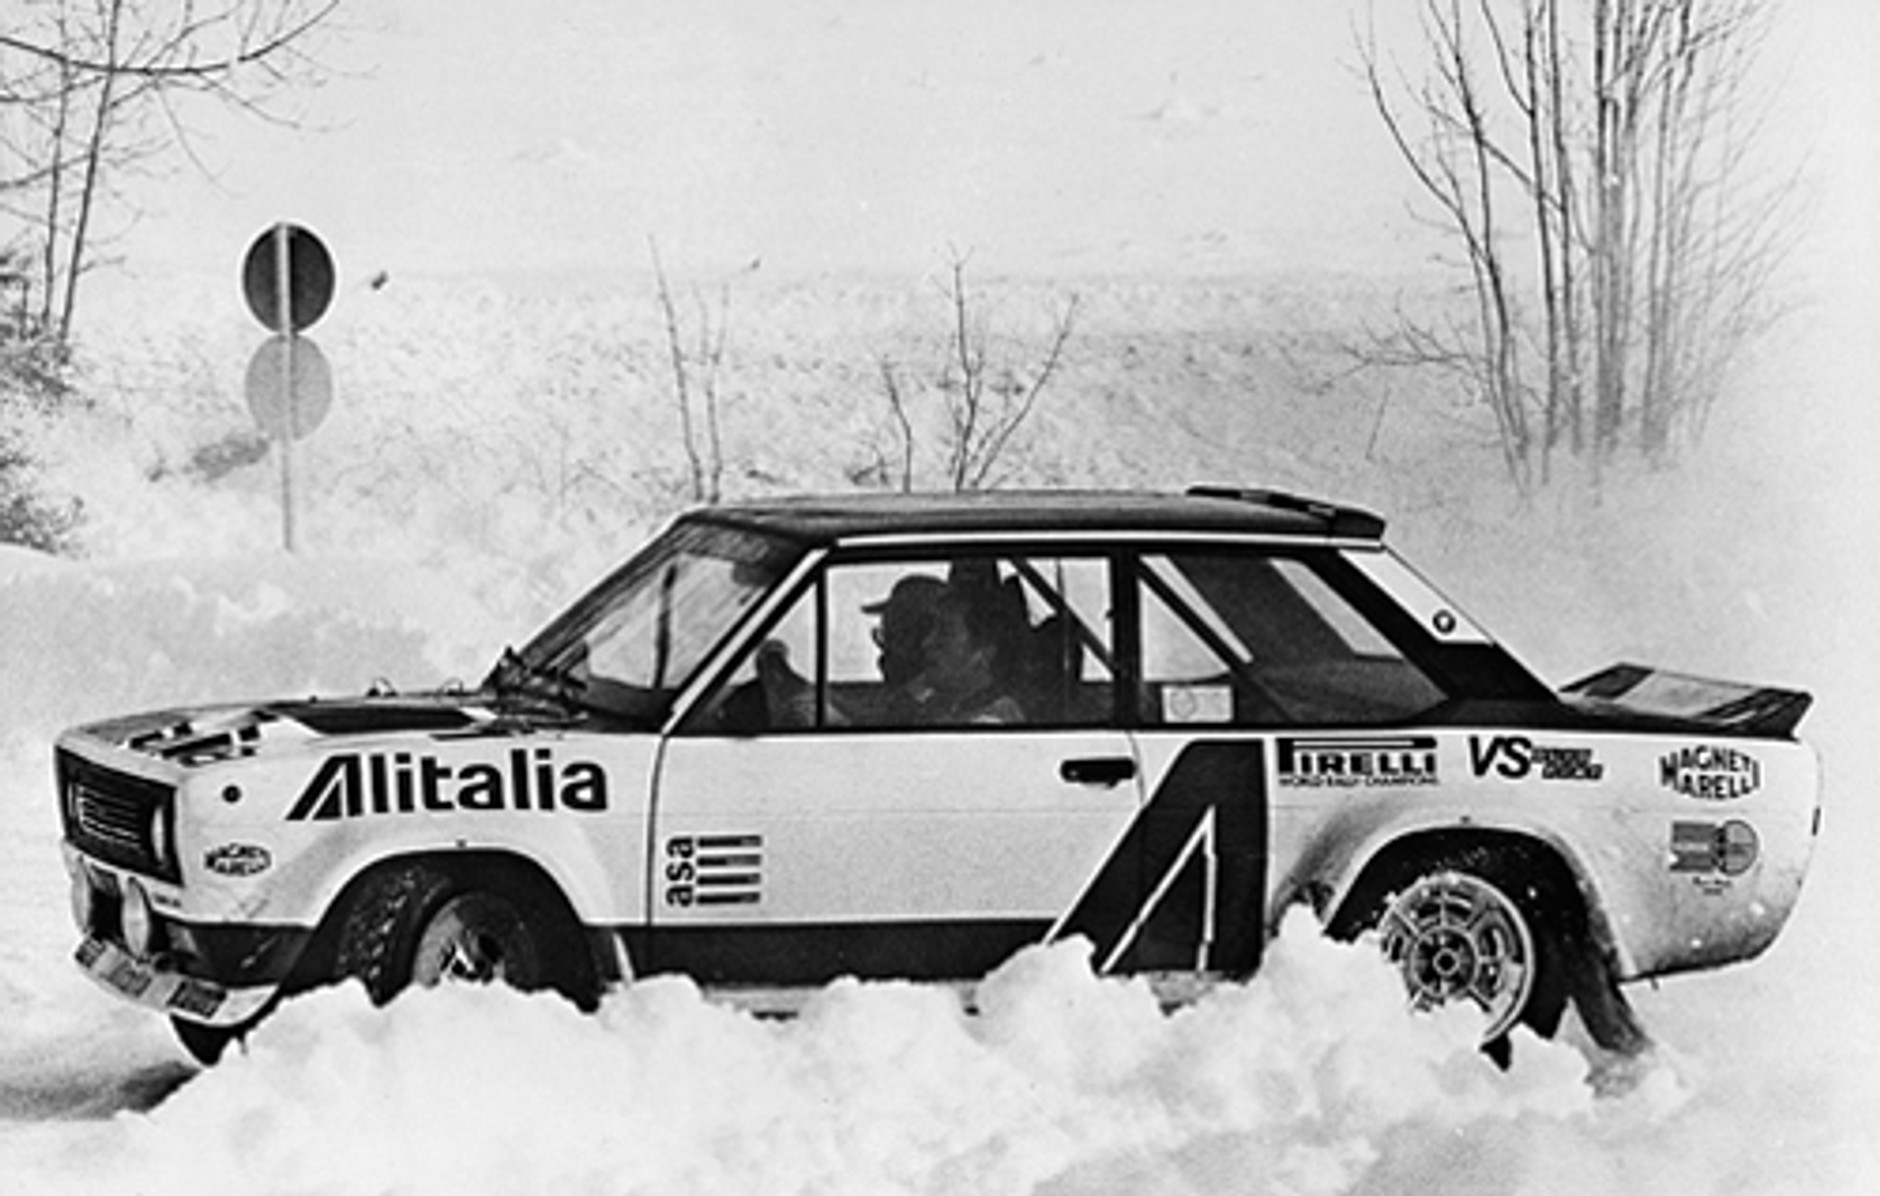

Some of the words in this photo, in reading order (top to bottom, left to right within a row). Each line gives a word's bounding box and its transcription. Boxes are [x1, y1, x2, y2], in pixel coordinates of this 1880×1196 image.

[1276, 737, 1437, 774] PIRELLI
[1469, 736, 1532, 779] VS
[1660, 745, 1760, 776] MAGNETI
[285, 748, 608, 821] Alitalia
[1660, 769, 1760, 798] MARELLI
[665, 836, 694, 907] asa
